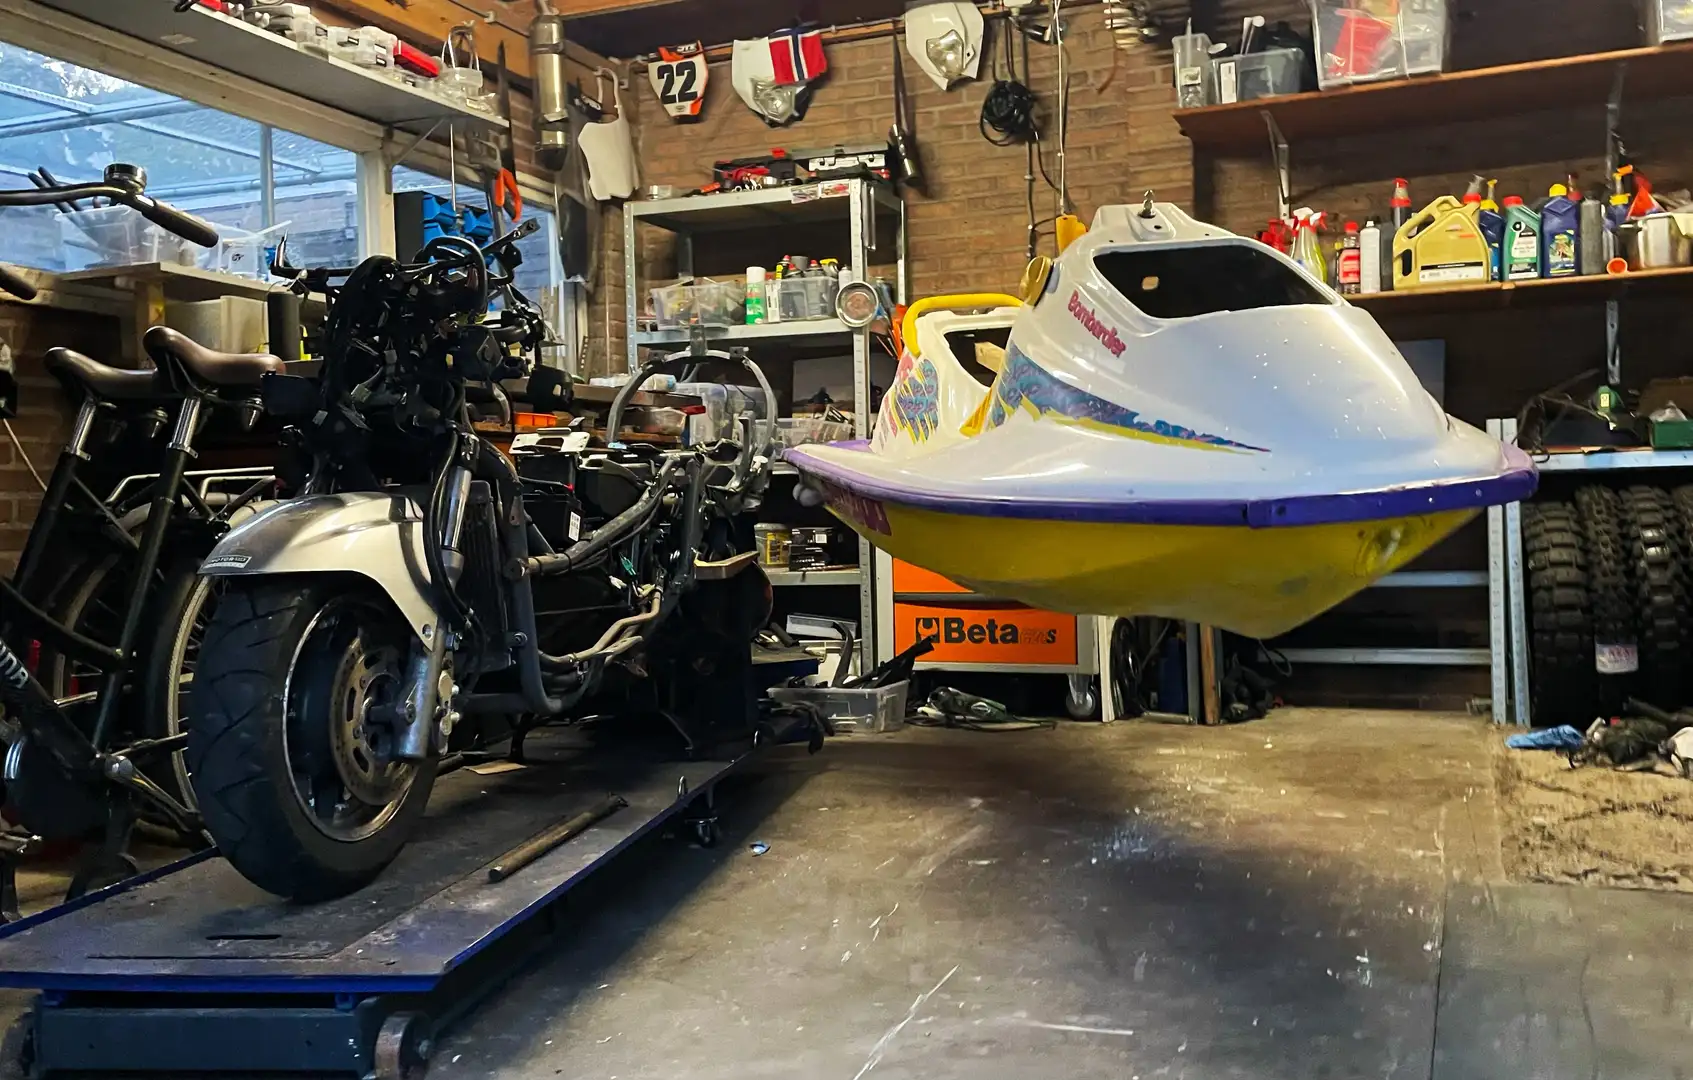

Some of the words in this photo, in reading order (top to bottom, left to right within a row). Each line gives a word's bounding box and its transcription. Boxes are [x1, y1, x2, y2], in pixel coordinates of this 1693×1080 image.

[657, 60, 698, 104] 22
[1068, 289, 1126, 358] Bombardier
[944, 618, 1018, 644] Beta
